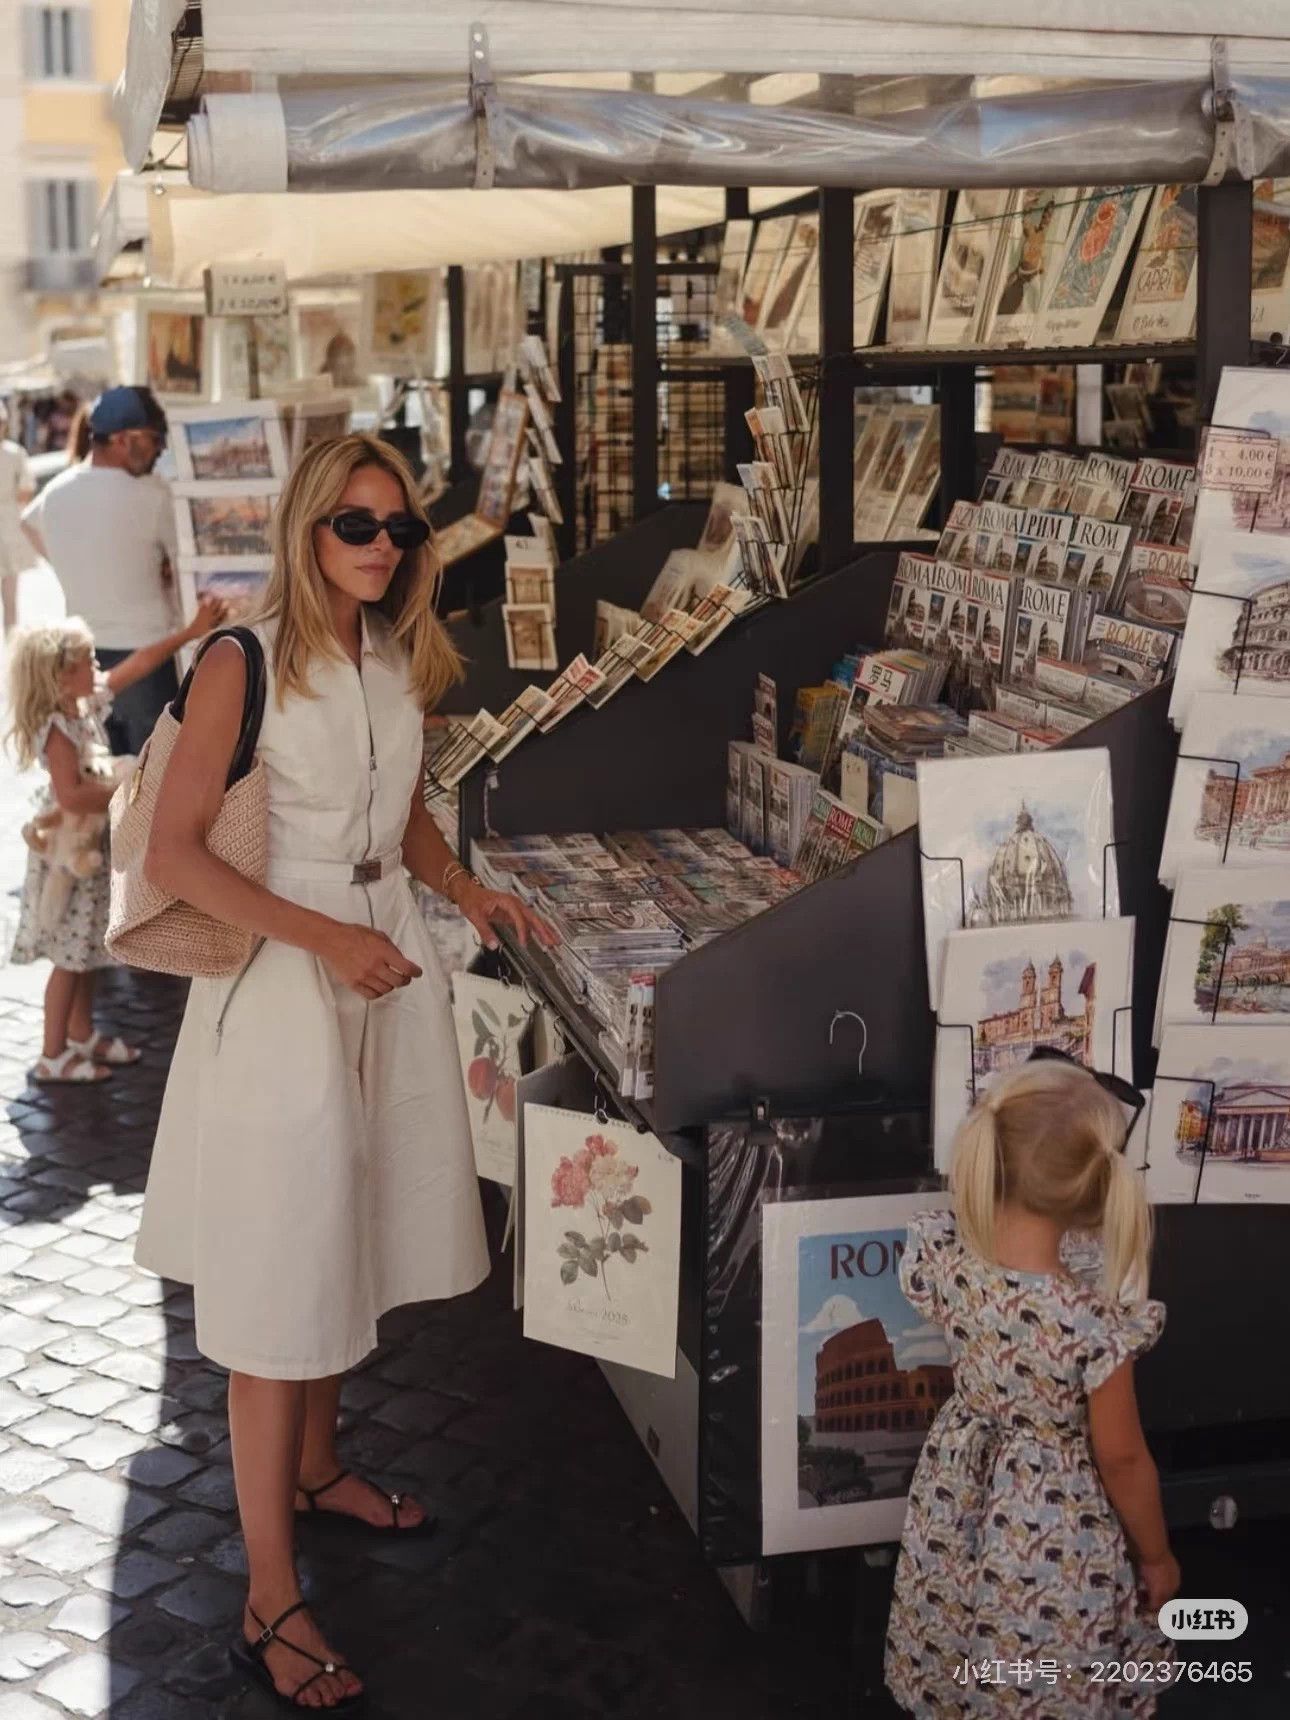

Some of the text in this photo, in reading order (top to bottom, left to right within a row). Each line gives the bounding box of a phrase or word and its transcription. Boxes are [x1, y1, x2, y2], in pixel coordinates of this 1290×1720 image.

[1141, 463, 1193, 491] ROME
[983, 505, 1018, 533] ROMA
[1079, 525, 1119, 550] ROM
[899, 559, 930, 588] ROMA
[972, 575, 1003, 605] ROMA
[1023, 584, 1065, 617] ROME
[1104, 621, 1154, 653] ROME
